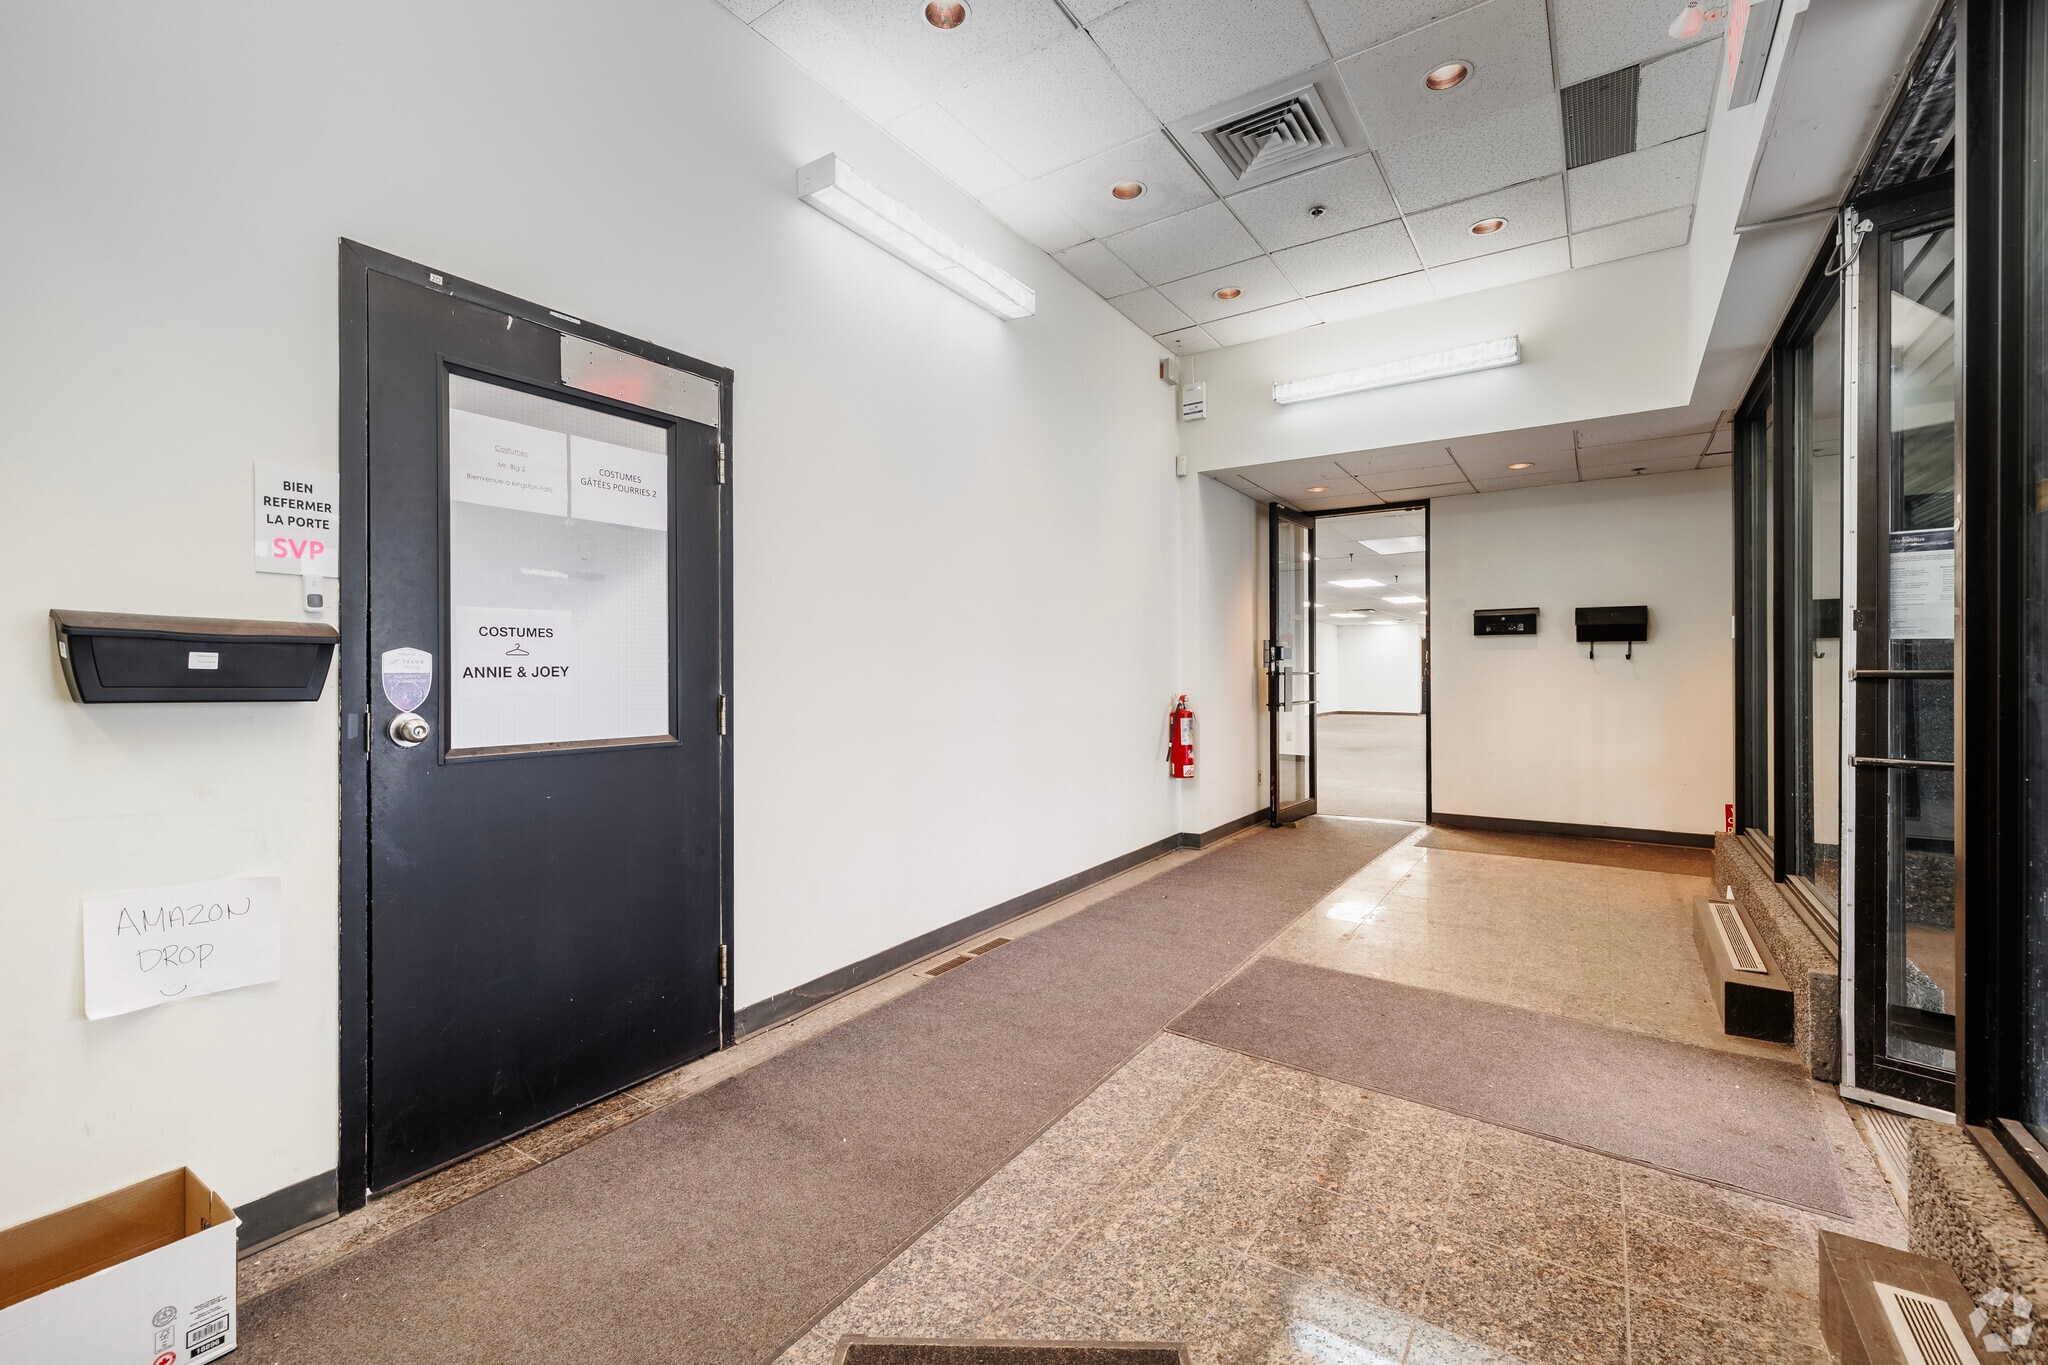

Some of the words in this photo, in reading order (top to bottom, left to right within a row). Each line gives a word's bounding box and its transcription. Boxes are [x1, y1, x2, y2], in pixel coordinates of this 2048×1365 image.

[494, 444, 528, 457] Costumes
[510, 463, 520, 472] Big
[466, 473, 504, 485] Bienvenue
[598, 468, 642, 484] COSTUMES
[283, 481, 313, 494] BIEN
[580, 476, 611, 490] GÂTÉES
[613, 483, 651, 497] POURRIES
[652, 490, 657, 498] 2
[263, 495, 332, 513] REFERMER
[266, 513, 284, 525] LA
[287, 516, 330, 530] PORTE
[273, 537, 325, 560] SVP
[478, 626, 554, 638] COSTUMES
[462, 666, 512, 678] ANNIE
[517, 666, 527, 678] &
[531, 666, 569, 678] JOEY
[117, 897, 251, 936] AMAZON
[136, 943, 214, 973] DROP
